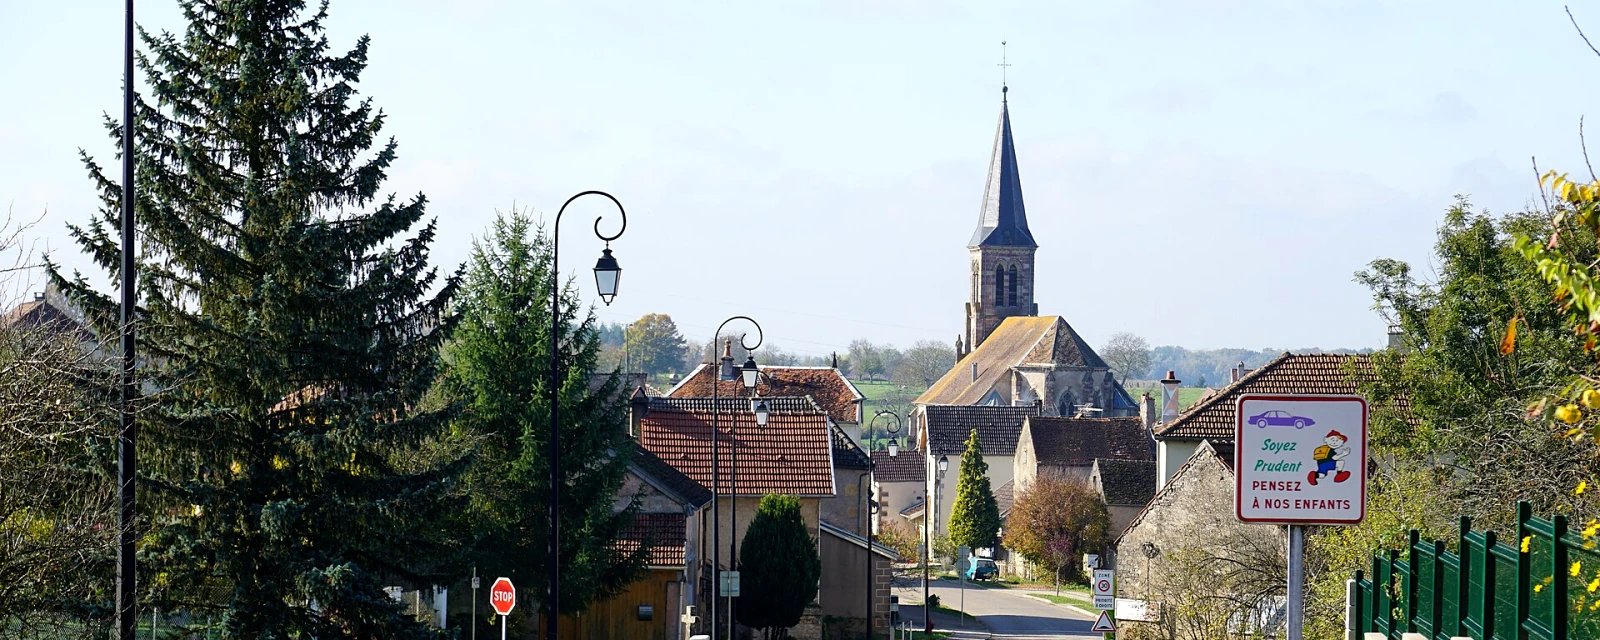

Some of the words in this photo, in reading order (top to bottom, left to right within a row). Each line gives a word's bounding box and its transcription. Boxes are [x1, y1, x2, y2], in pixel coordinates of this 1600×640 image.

[1261, 438, 1297, 454] Soyez
[1253, 459, 1302, 472] Prudent
[1252, 481, 1301, 492] PENSEZ
[1252, 496, 1260, 509] À
[1265, 499, 1290, 509] NOS
[1295, 499, 1351, 510] ENFANTS
[494, 591, 513, 602] STOP
